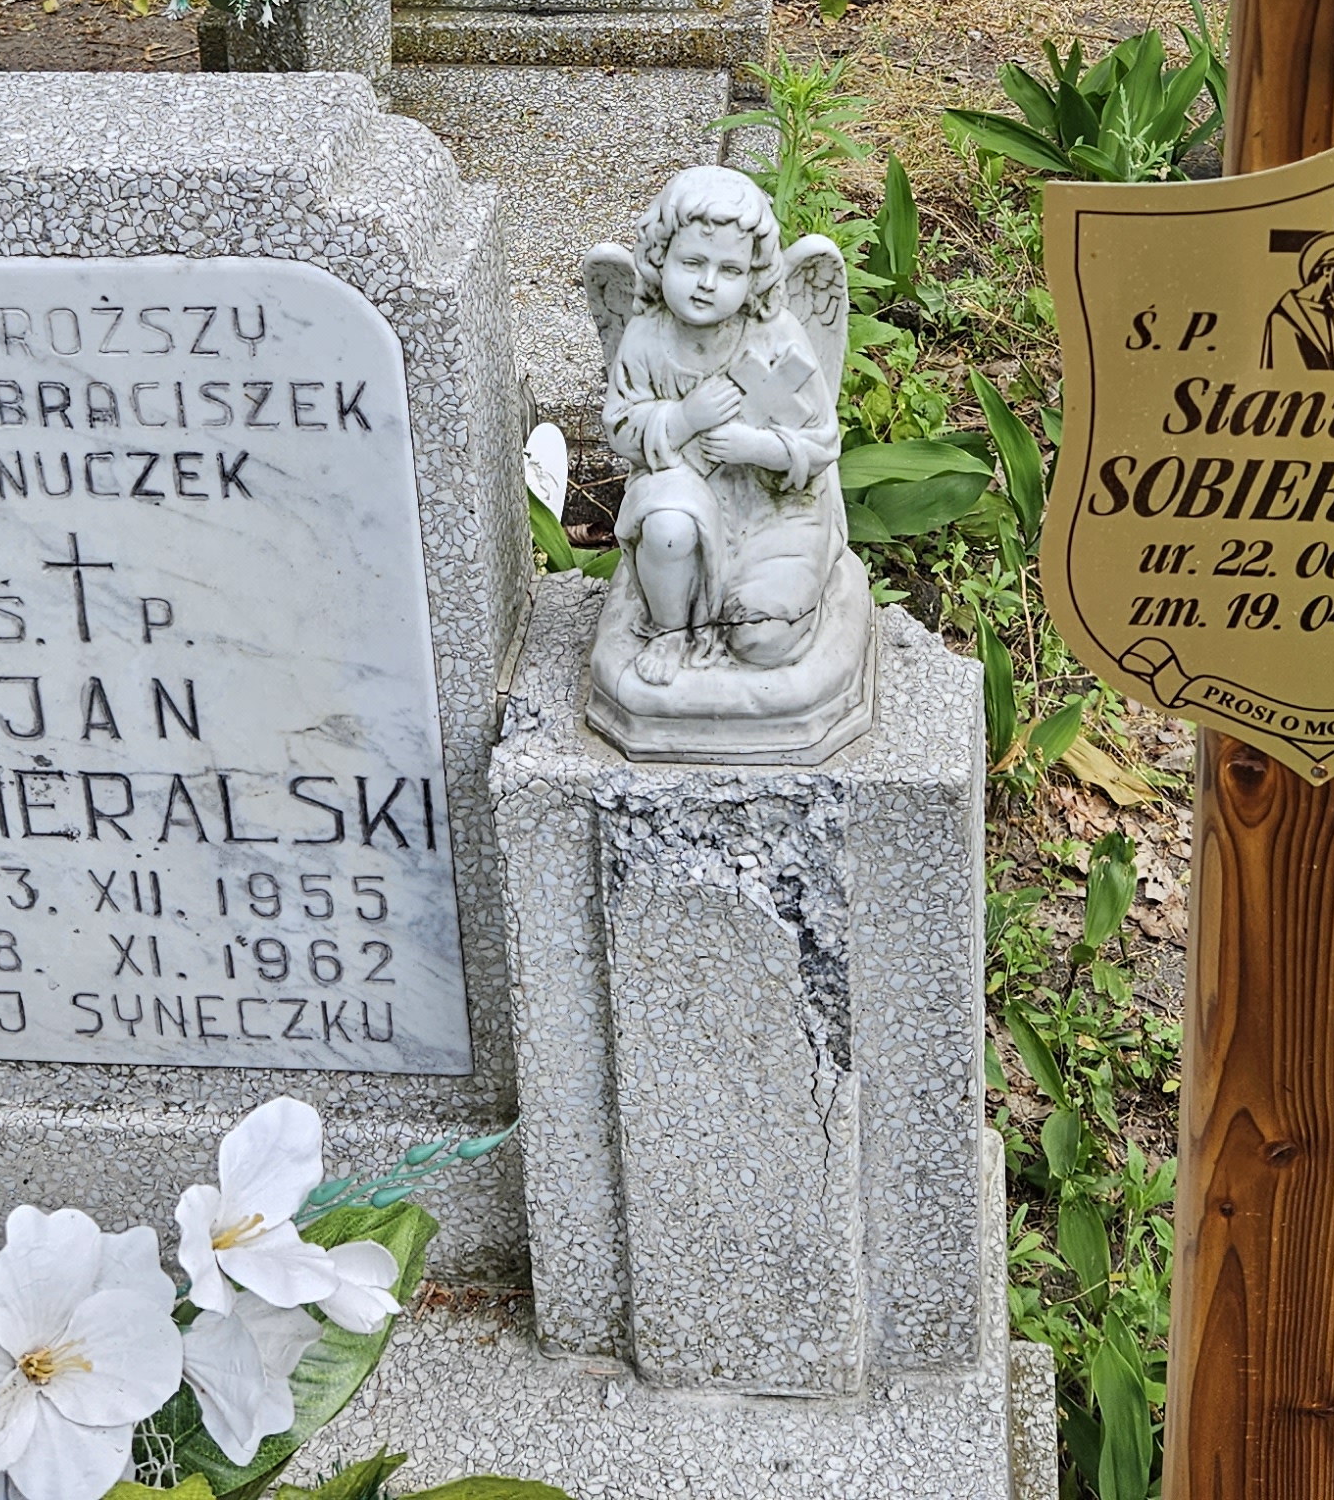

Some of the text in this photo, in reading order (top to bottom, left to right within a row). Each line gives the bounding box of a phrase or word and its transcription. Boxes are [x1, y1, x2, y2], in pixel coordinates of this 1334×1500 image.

[1125, 304, 1218, 352] Ś. P.
[1139, 540, 1198, 576] ur.
[1213, 539, 1277, 579] 22.
[1128, 595, 1207, 628] zm.
[1226, 593, 1282, 631] 19.
[1202, 685, 1275, 725] PROSI
[1281, 715, 1299, 731] O
[218, 871, 391, 924] 1955
[222, 934, 398, 985] 1962
[69, 991, 395, 1044] SYNECZKU
